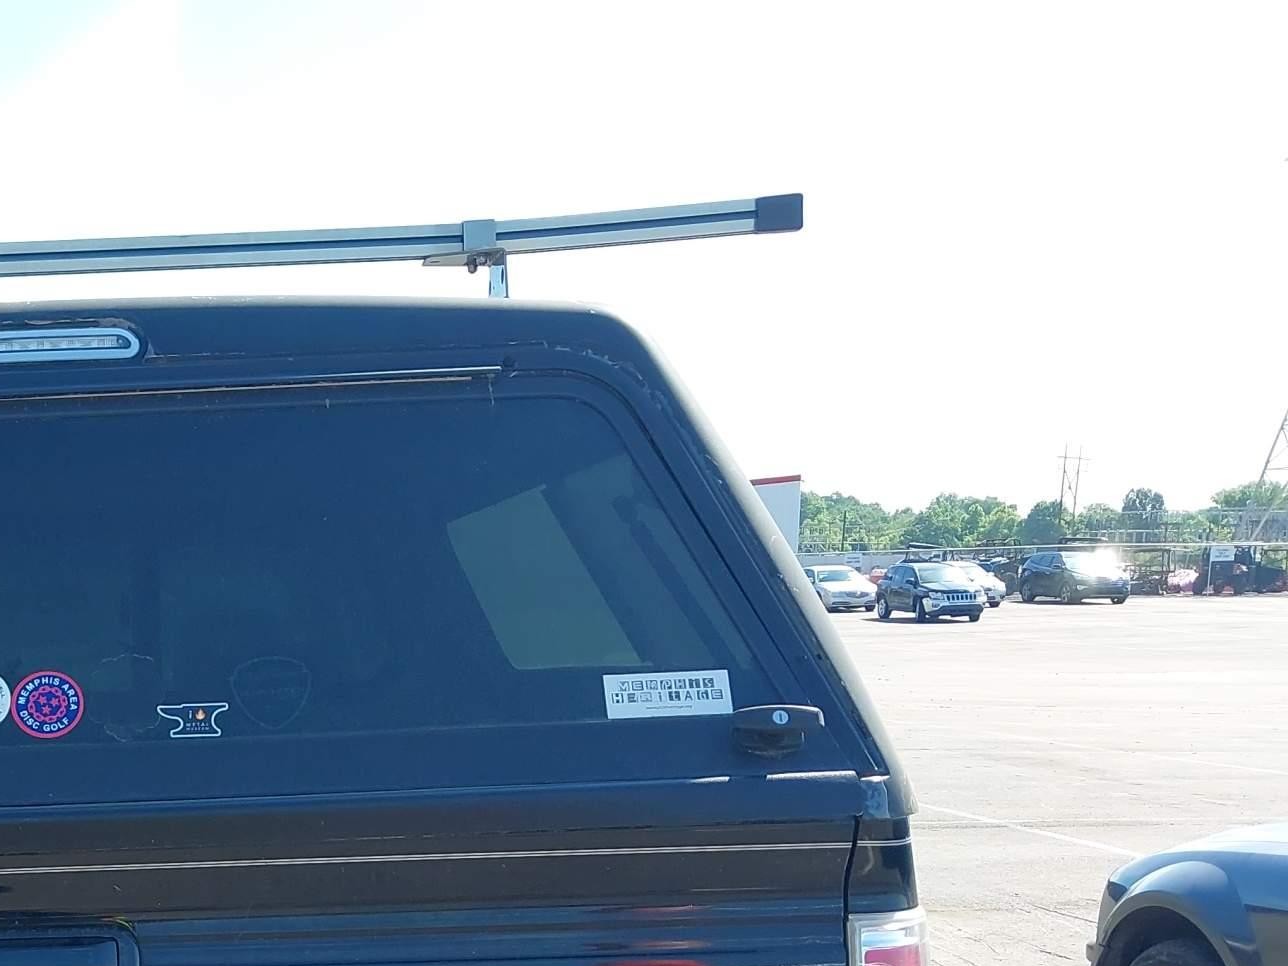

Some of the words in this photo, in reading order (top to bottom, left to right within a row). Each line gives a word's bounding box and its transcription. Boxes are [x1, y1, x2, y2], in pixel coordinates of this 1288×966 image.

[17, 676, 60, 705] MEMPHIS
[61, 683, 78, 710] AREA
[618, 678, 715, 691] MEMPHIS
[19, 710, 40, 730] DISC
[43, 717, 69, 732] GOLF
